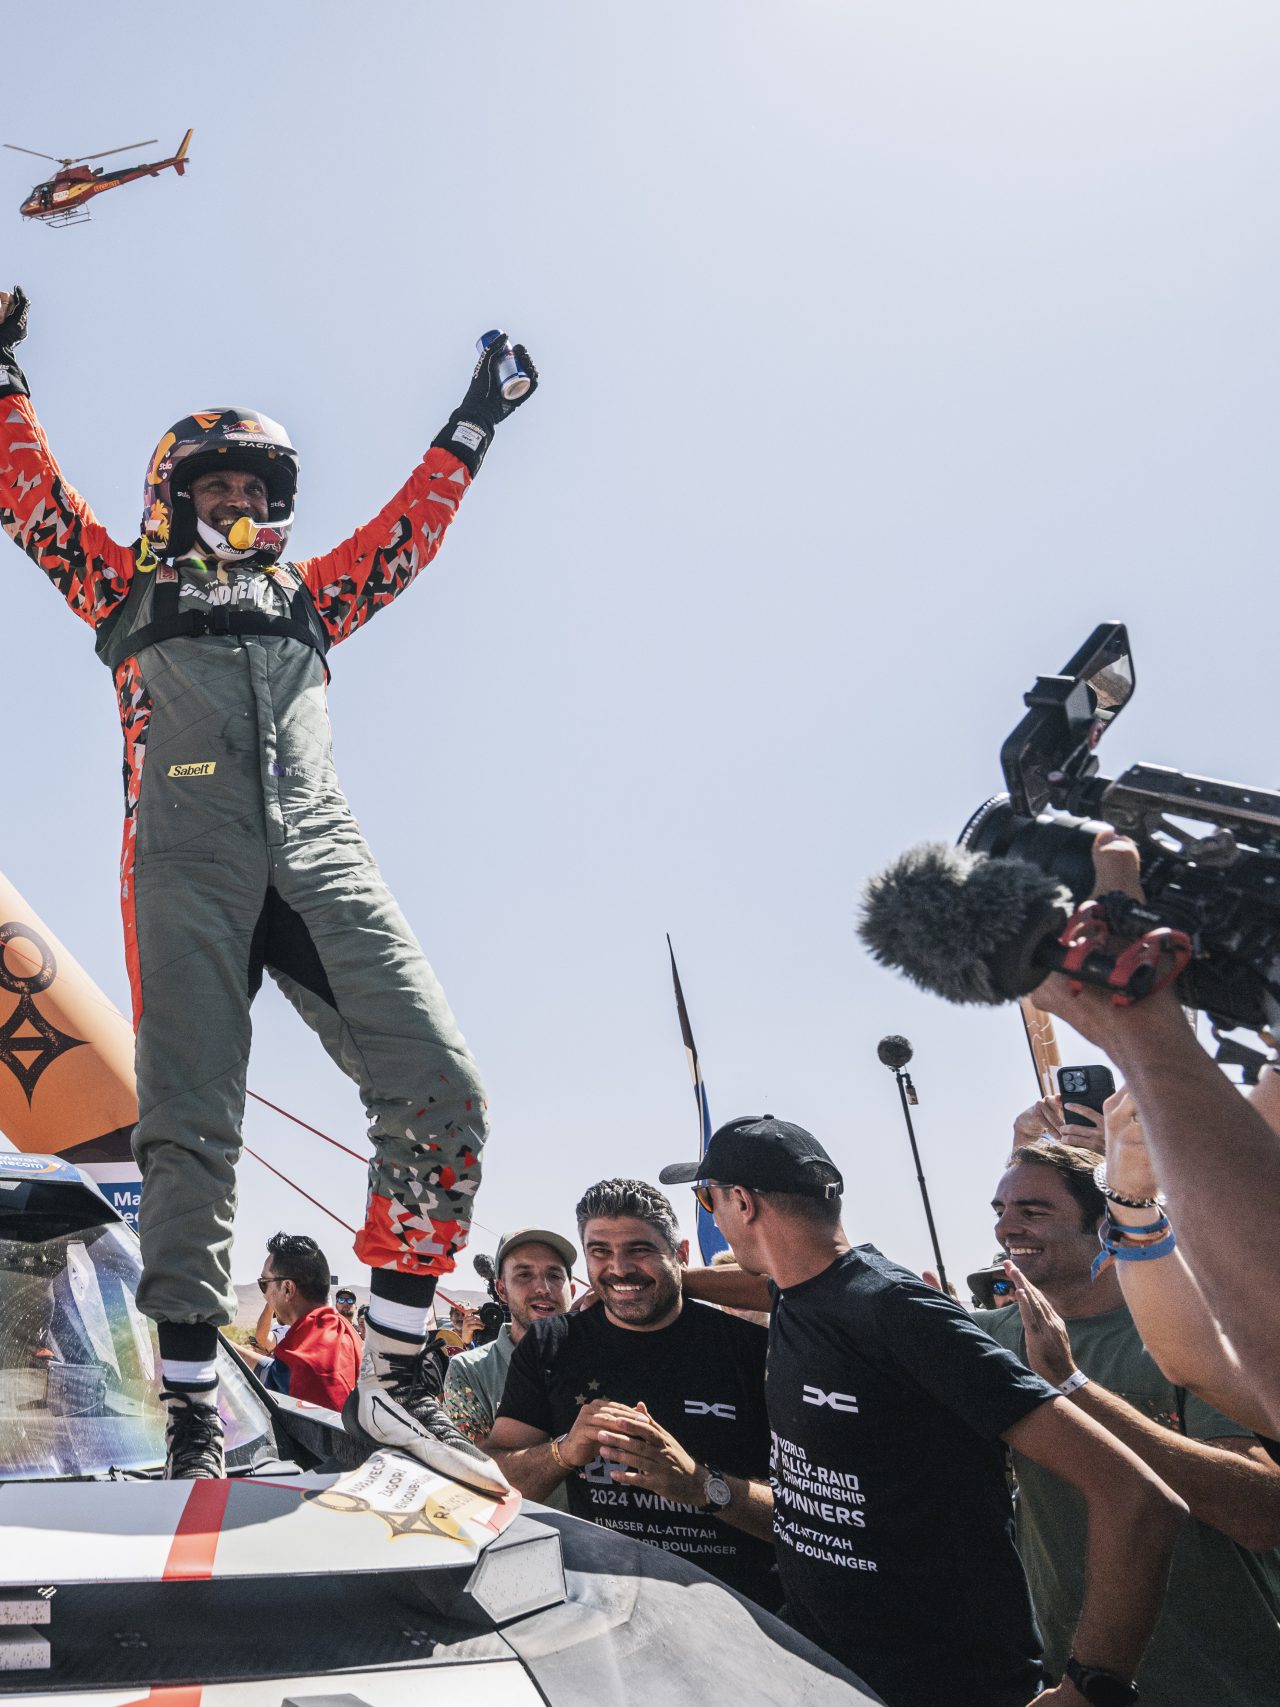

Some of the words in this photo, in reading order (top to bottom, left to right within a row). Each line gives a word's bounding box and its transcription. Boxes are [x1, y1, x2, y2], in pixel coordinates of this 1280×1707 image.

[238, 441, 276, 450] DACIA
[173, 764, 210, 776] Sabelt
[590, 1488, 630, 1507] 2024
[606, 1518, 644, 1533] NASSER
[647, 1523, 717, 1540] AL-ATTIYAH
[662, 1540, 737, 1556] BOULANGER
[795, 1541, 879, 1573] BOULANGER
